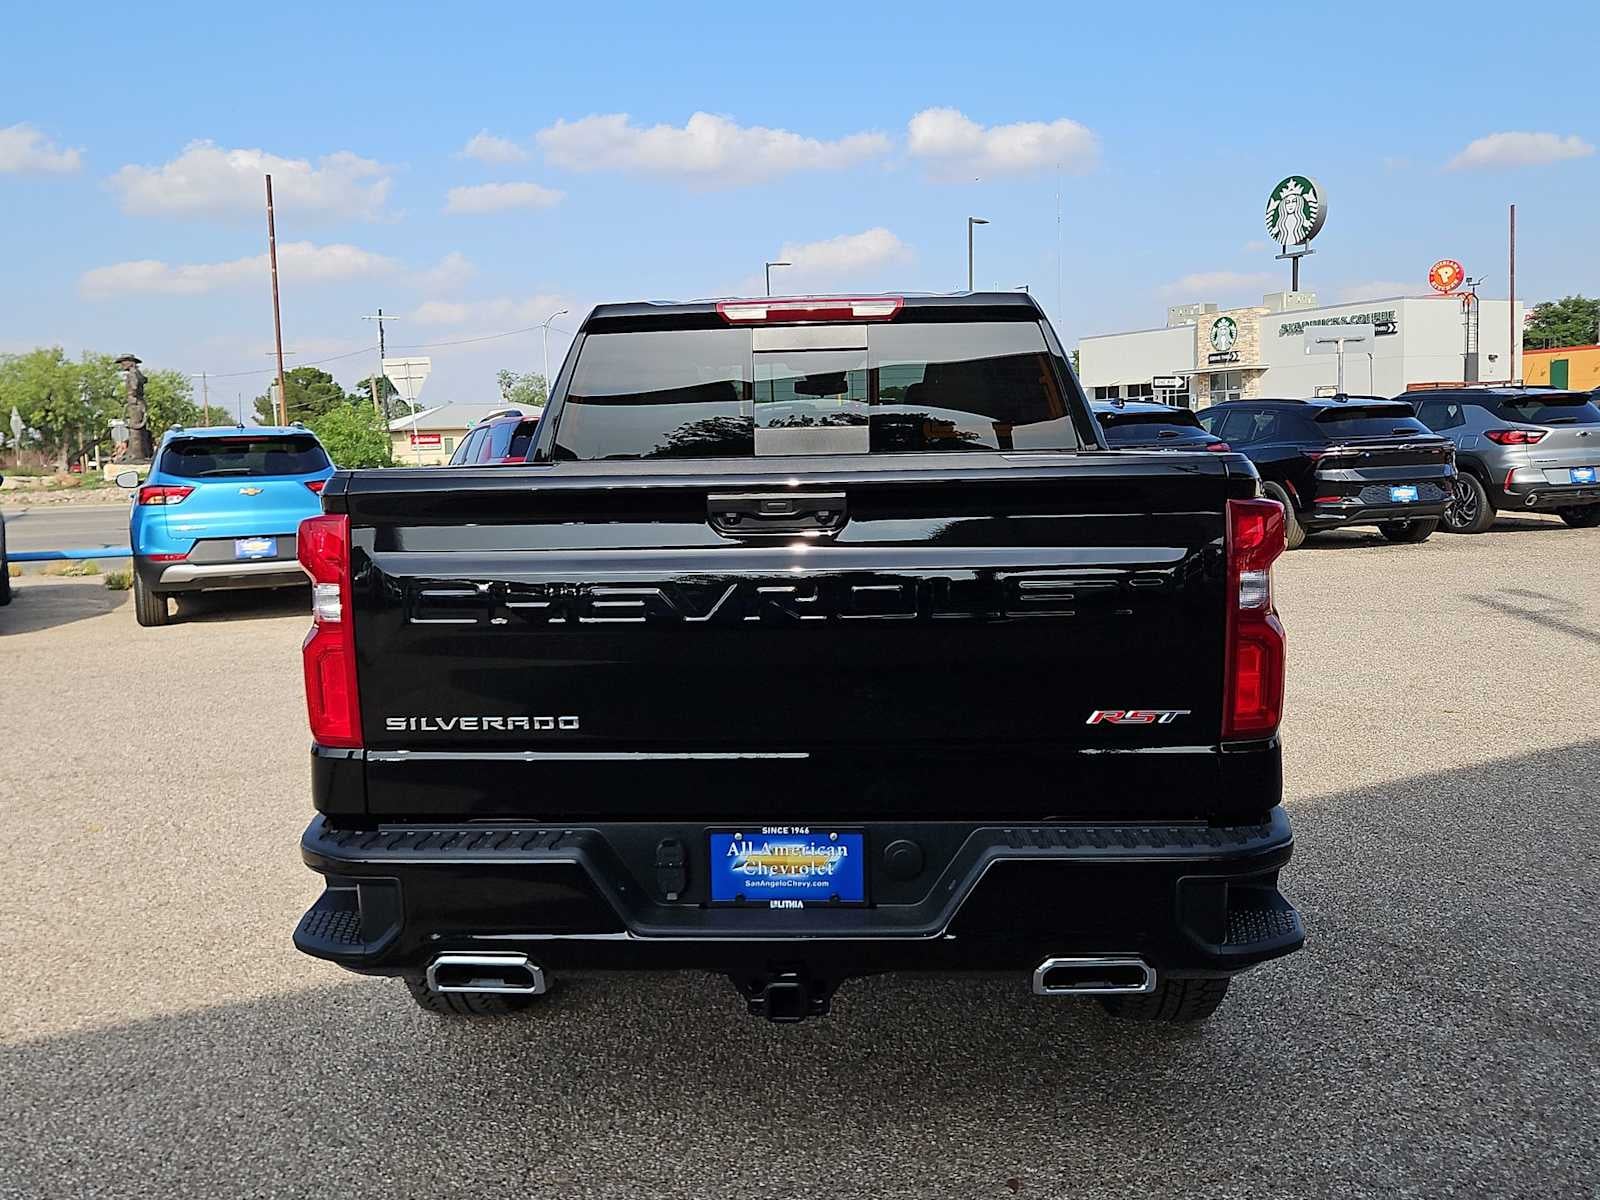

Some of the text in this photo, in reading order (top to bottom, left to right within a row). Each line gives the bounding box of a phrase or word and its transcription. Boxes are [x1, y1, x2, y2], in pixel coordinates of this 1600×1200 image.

[385, 715, 580, 731] SILVERADO
[1085, 709, 1192, 724] RST
[726, 841, 848, 857] All American
[743, 861, 834, 876] Chevrolet
[745, 880, 829, 888] SanAngeloChevy.com
